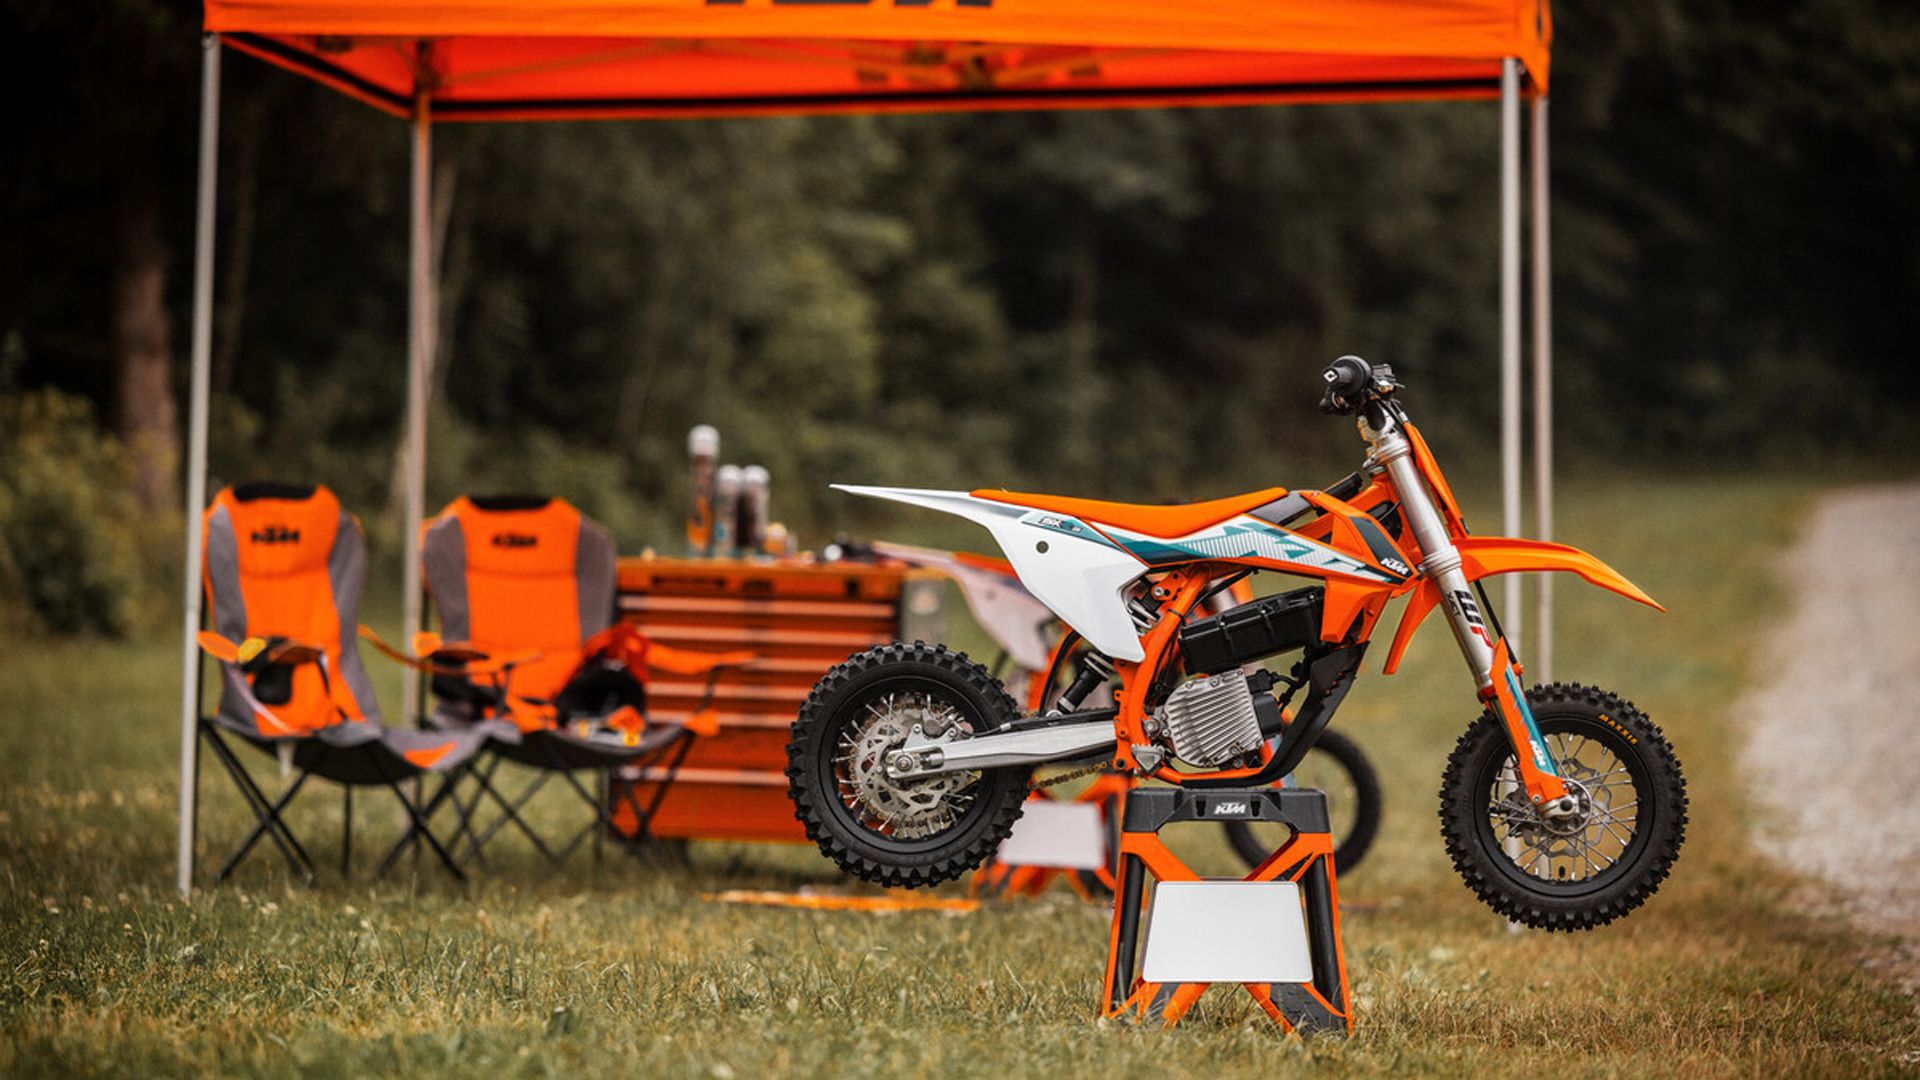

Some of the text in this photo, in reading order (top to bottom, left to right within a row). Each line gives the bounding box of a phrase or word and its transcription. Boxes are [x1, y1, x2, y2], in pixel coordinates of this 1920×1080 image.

[250, 525, 301, 545] KTM
[1380, 557, 1409, 575] KTM
[1453, 590, 1495, 650] WP
[1598, 713, 1638, 745] MAXXIS
[1214, 801, 1247, 815] KTM
